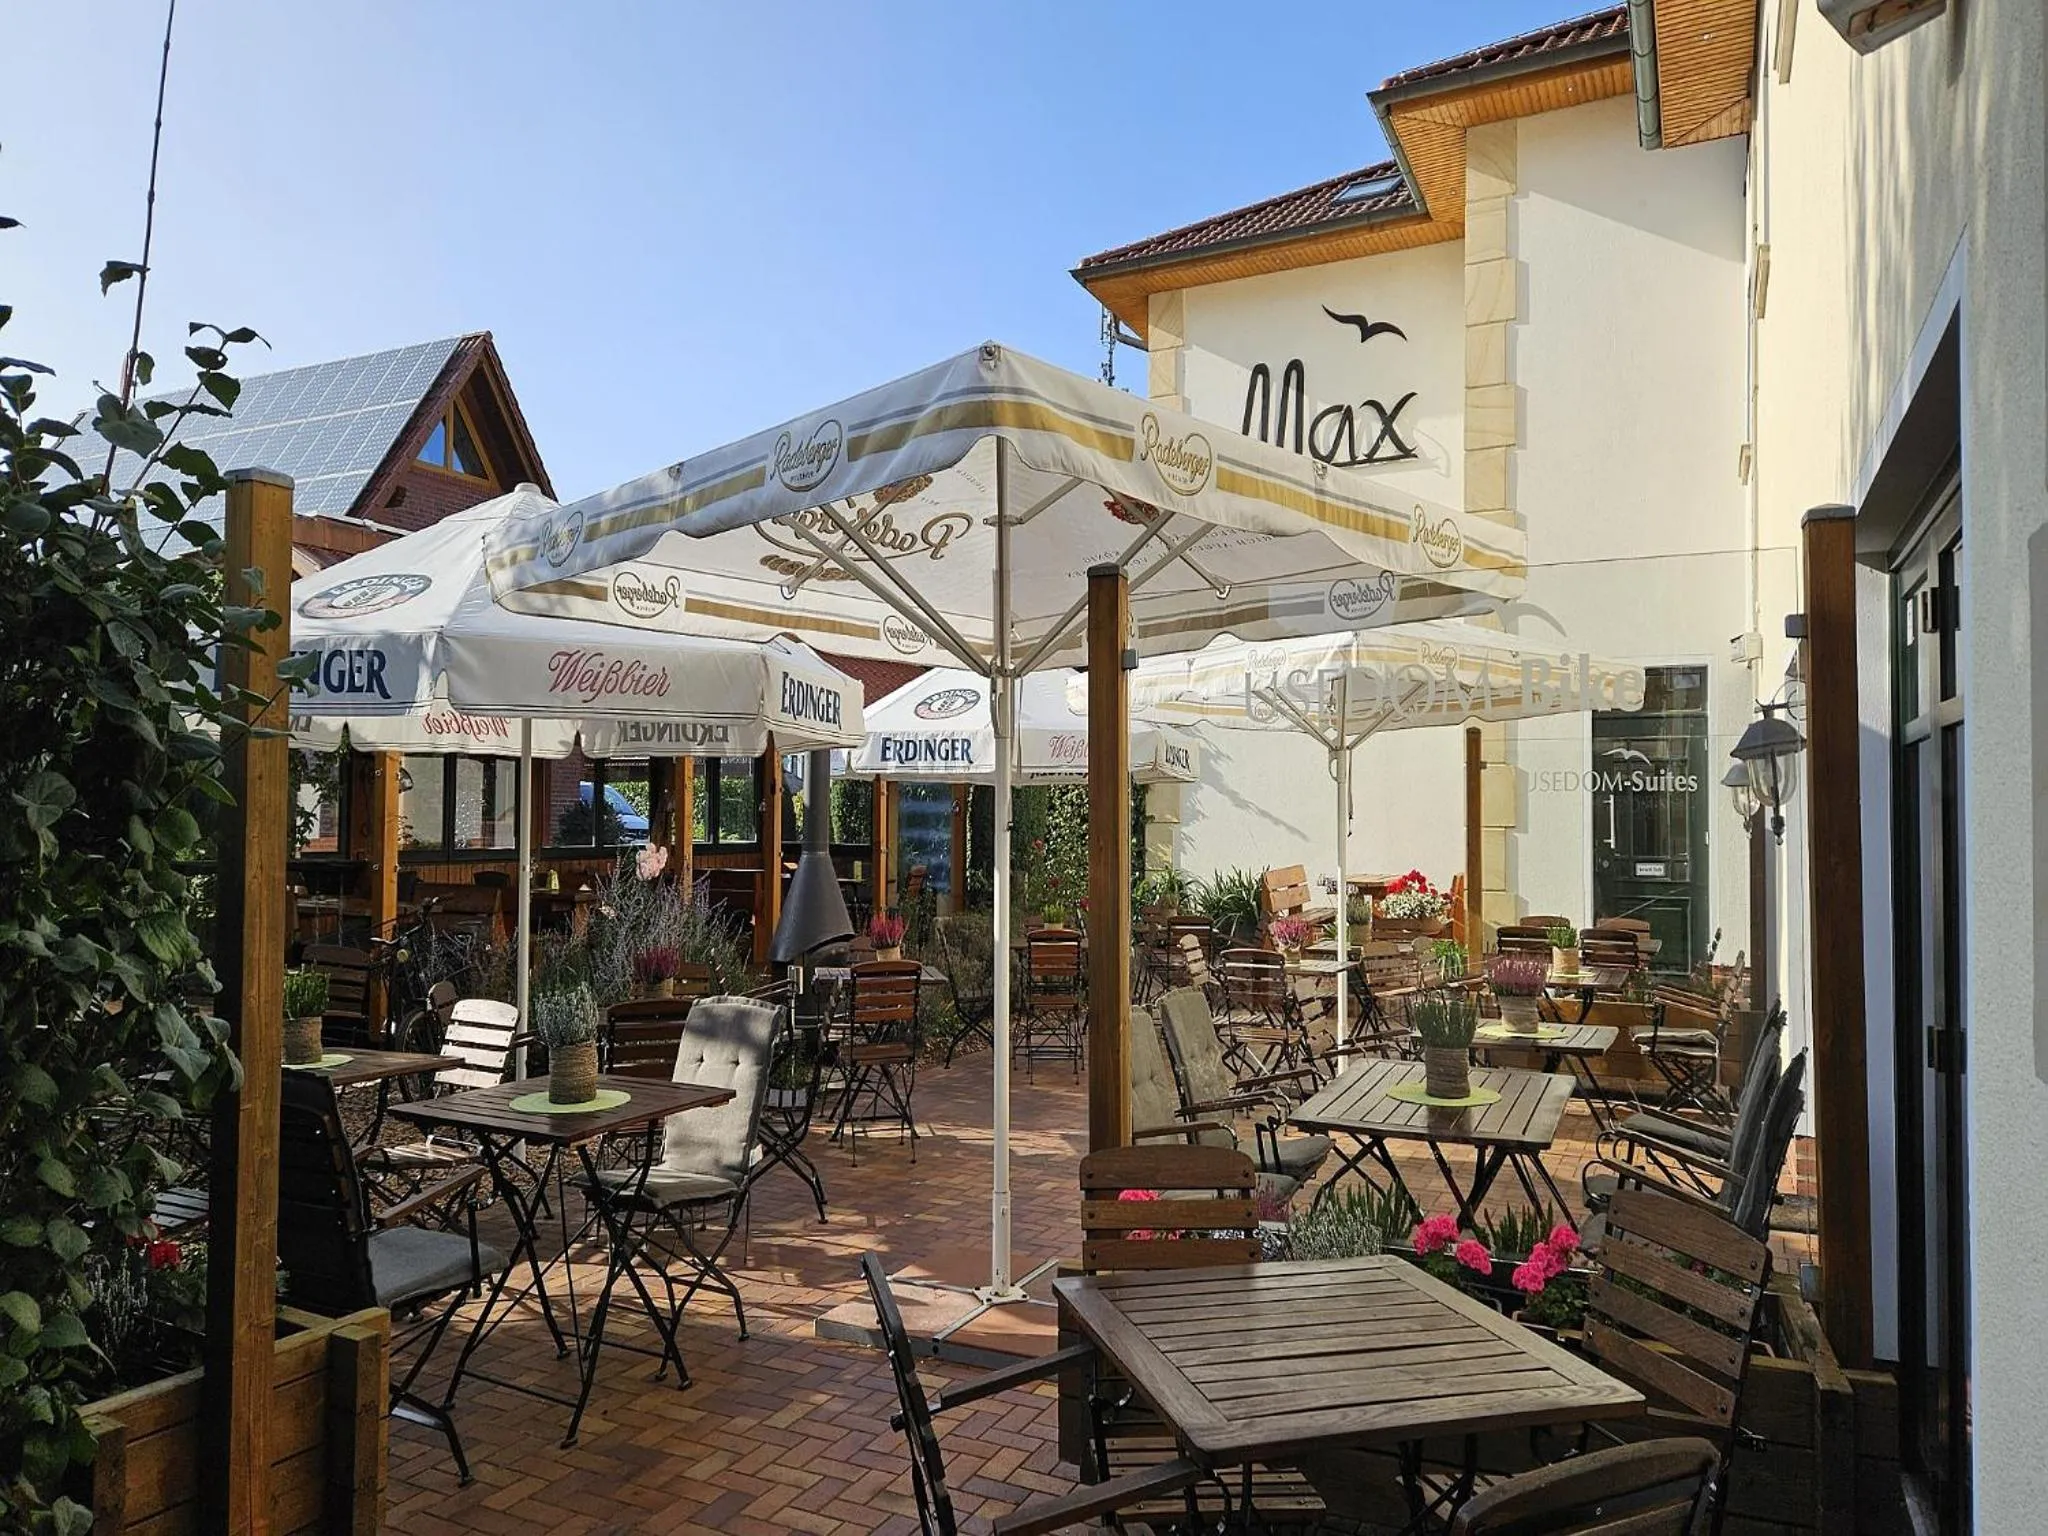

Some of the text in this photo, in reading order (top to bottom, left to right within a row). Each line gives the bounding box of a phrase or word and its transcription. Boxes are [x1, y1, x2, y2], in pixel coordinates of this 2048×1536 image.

[1241, 358, 1419, 467] Max
[548, 650, 671, 704] Weißbier
[781, 671, 842, 731] ERDINGER
[880, 737, 973, 765] ERDINGER
[1529, 768, 1699, 793] USEDOM-Suites
